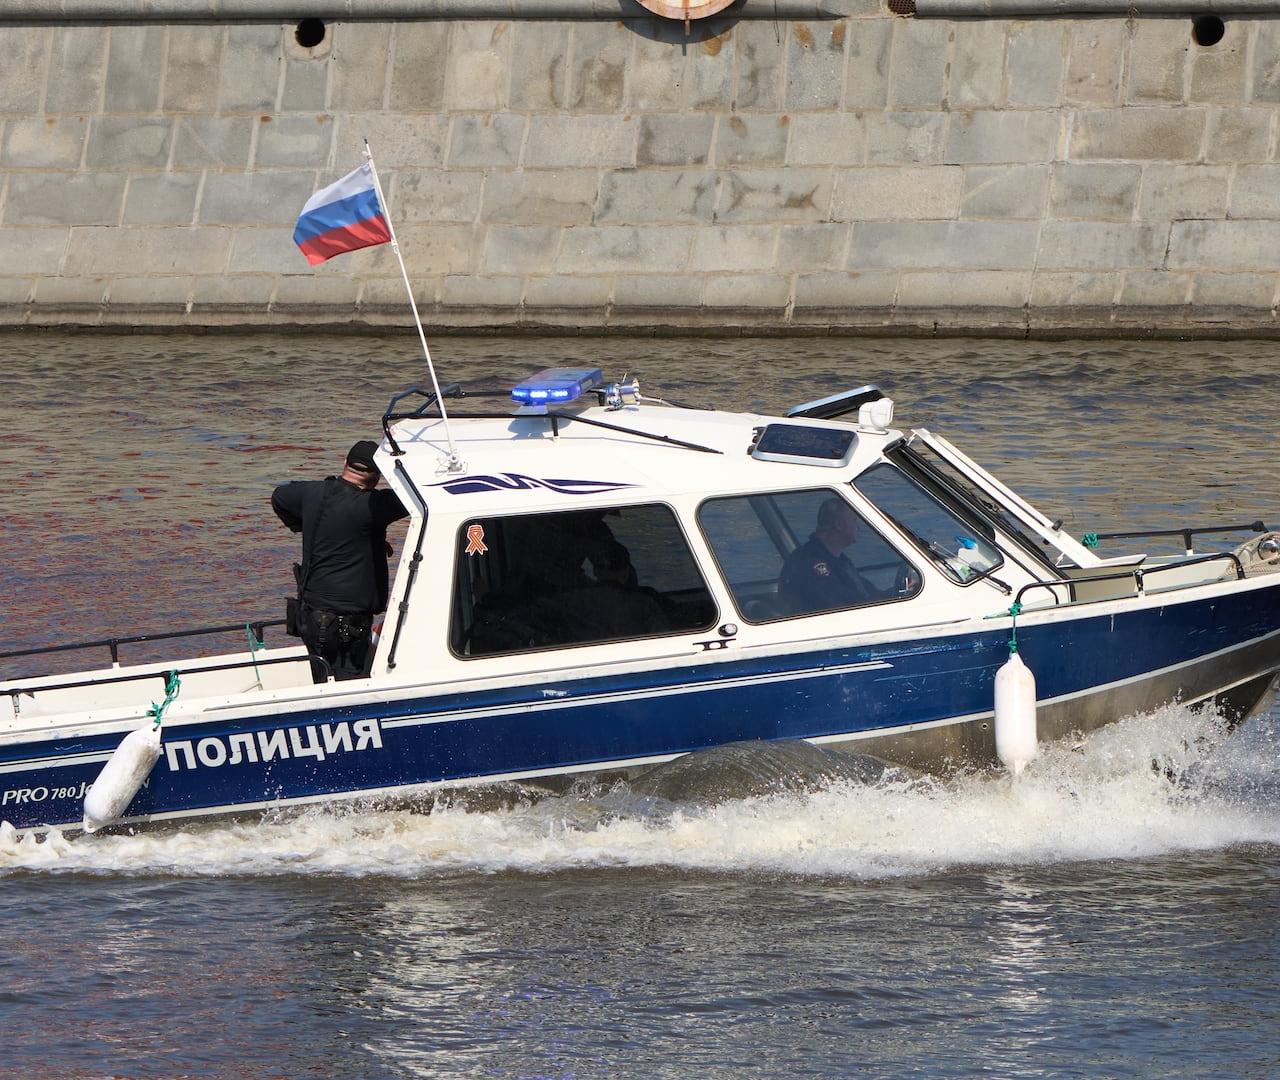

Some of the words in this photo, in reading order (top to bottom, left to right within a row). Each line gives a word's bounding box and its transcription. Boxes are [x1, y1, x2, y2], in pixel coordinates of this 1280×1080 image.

[164, 718, 384, 771] ПОЛИЦИЯ
[2, 784, 49, 806] PRO
[51, 786, 76, 800] 780
